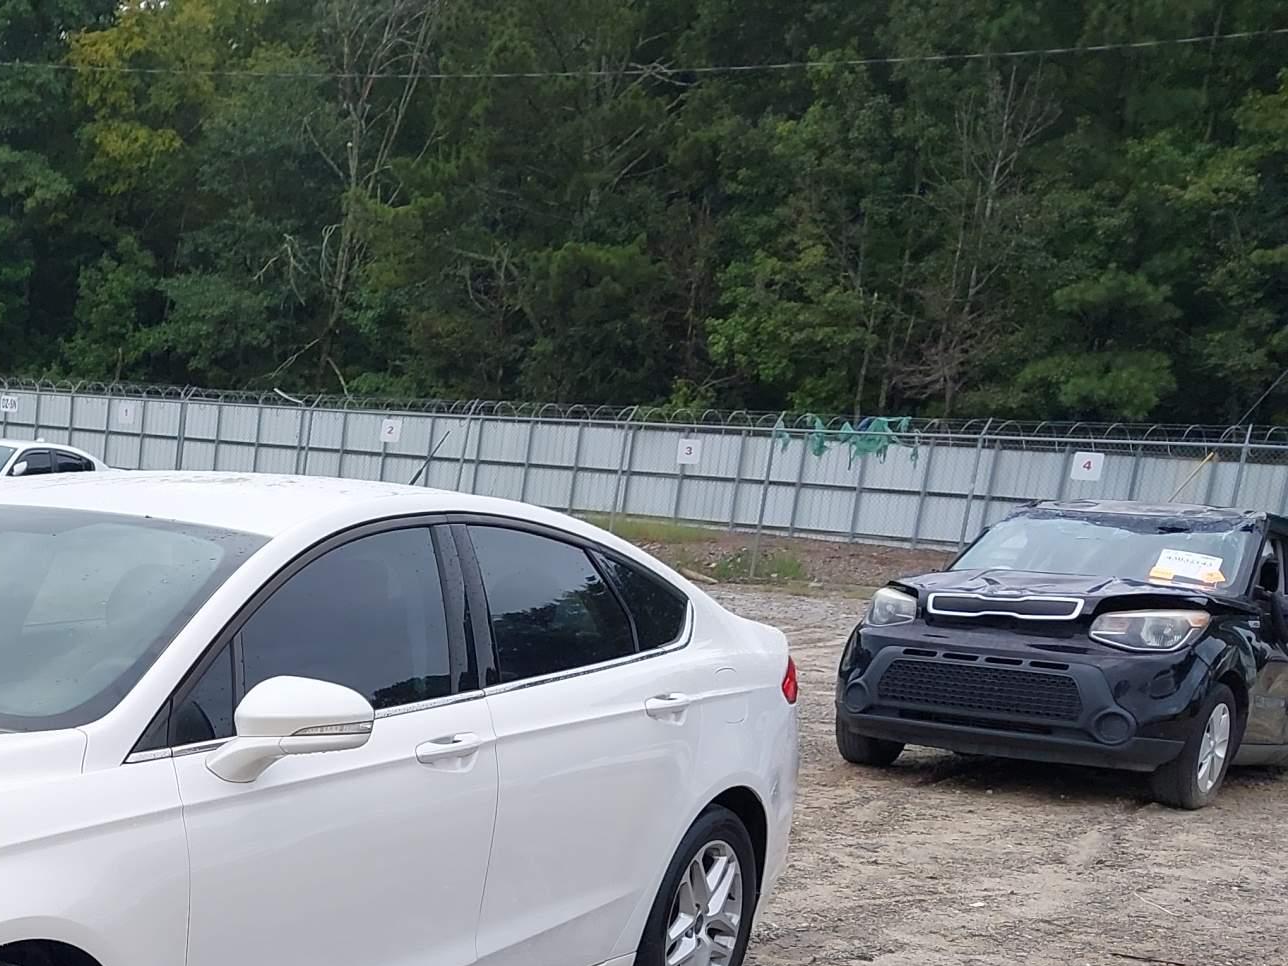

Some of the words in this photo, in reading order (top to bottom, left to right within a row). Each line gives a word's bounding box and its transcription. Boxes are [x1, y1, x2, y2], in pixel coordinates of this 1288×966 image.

[387, 425, 394, 435] 2
[685, 446, 693, 456] 3
[1083, 460, 1092, 471] 4
